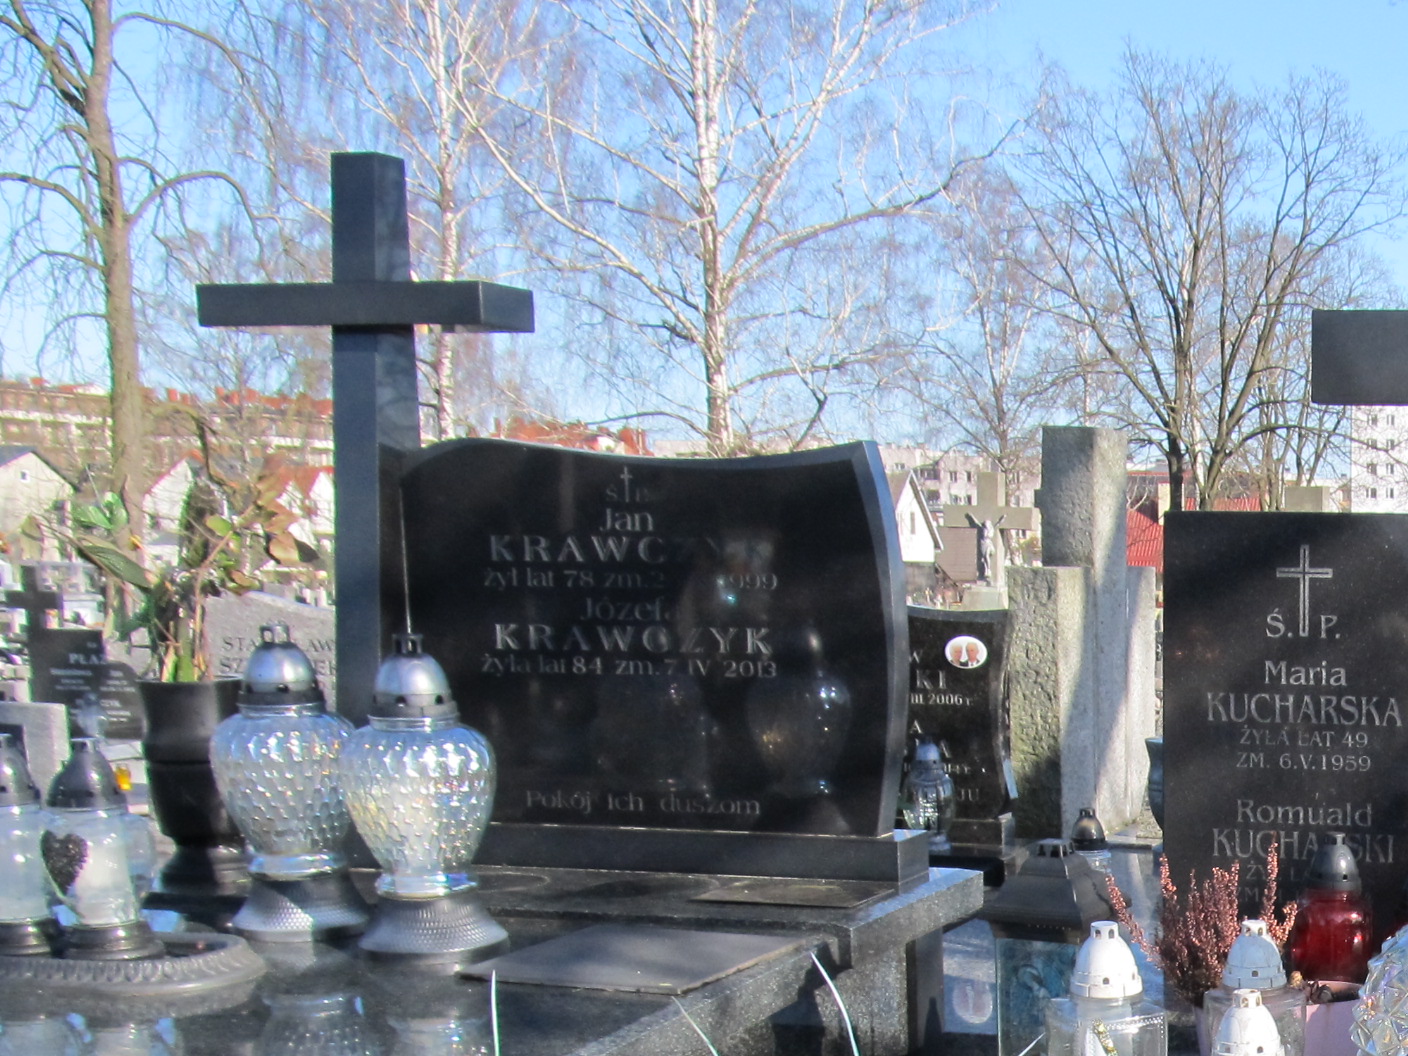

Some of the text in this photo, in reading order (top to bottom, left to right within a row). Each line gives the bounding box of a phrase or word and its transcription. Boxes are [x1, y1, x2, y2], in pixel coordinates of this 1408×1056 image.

[600, 508, 655, 533] Jan
[527, 567, 554, 588] lat
[563, 570, 595, 588] 78
[494, 622, 773, 655] KRAWCZYK
[572, 656, 603, 675] 84
[687, 659, 712, 677] IV
[723, 660, 778, 679] 2013
[1264, 660, 1348, 687] Maria
[928, 693, 963, 705] 2006
[1207, 692, 1403, 727] KUCHARSKA
[1239, 724, 1369, 748] ŻYŁA LAT 49
[1236, 752, 1270, 769] ZM.
[660, 793, 761, 816] duszom
[1236, 798, 1374, 827] Romuald
[1212, 827, 1395, 864] KUCHASKI
